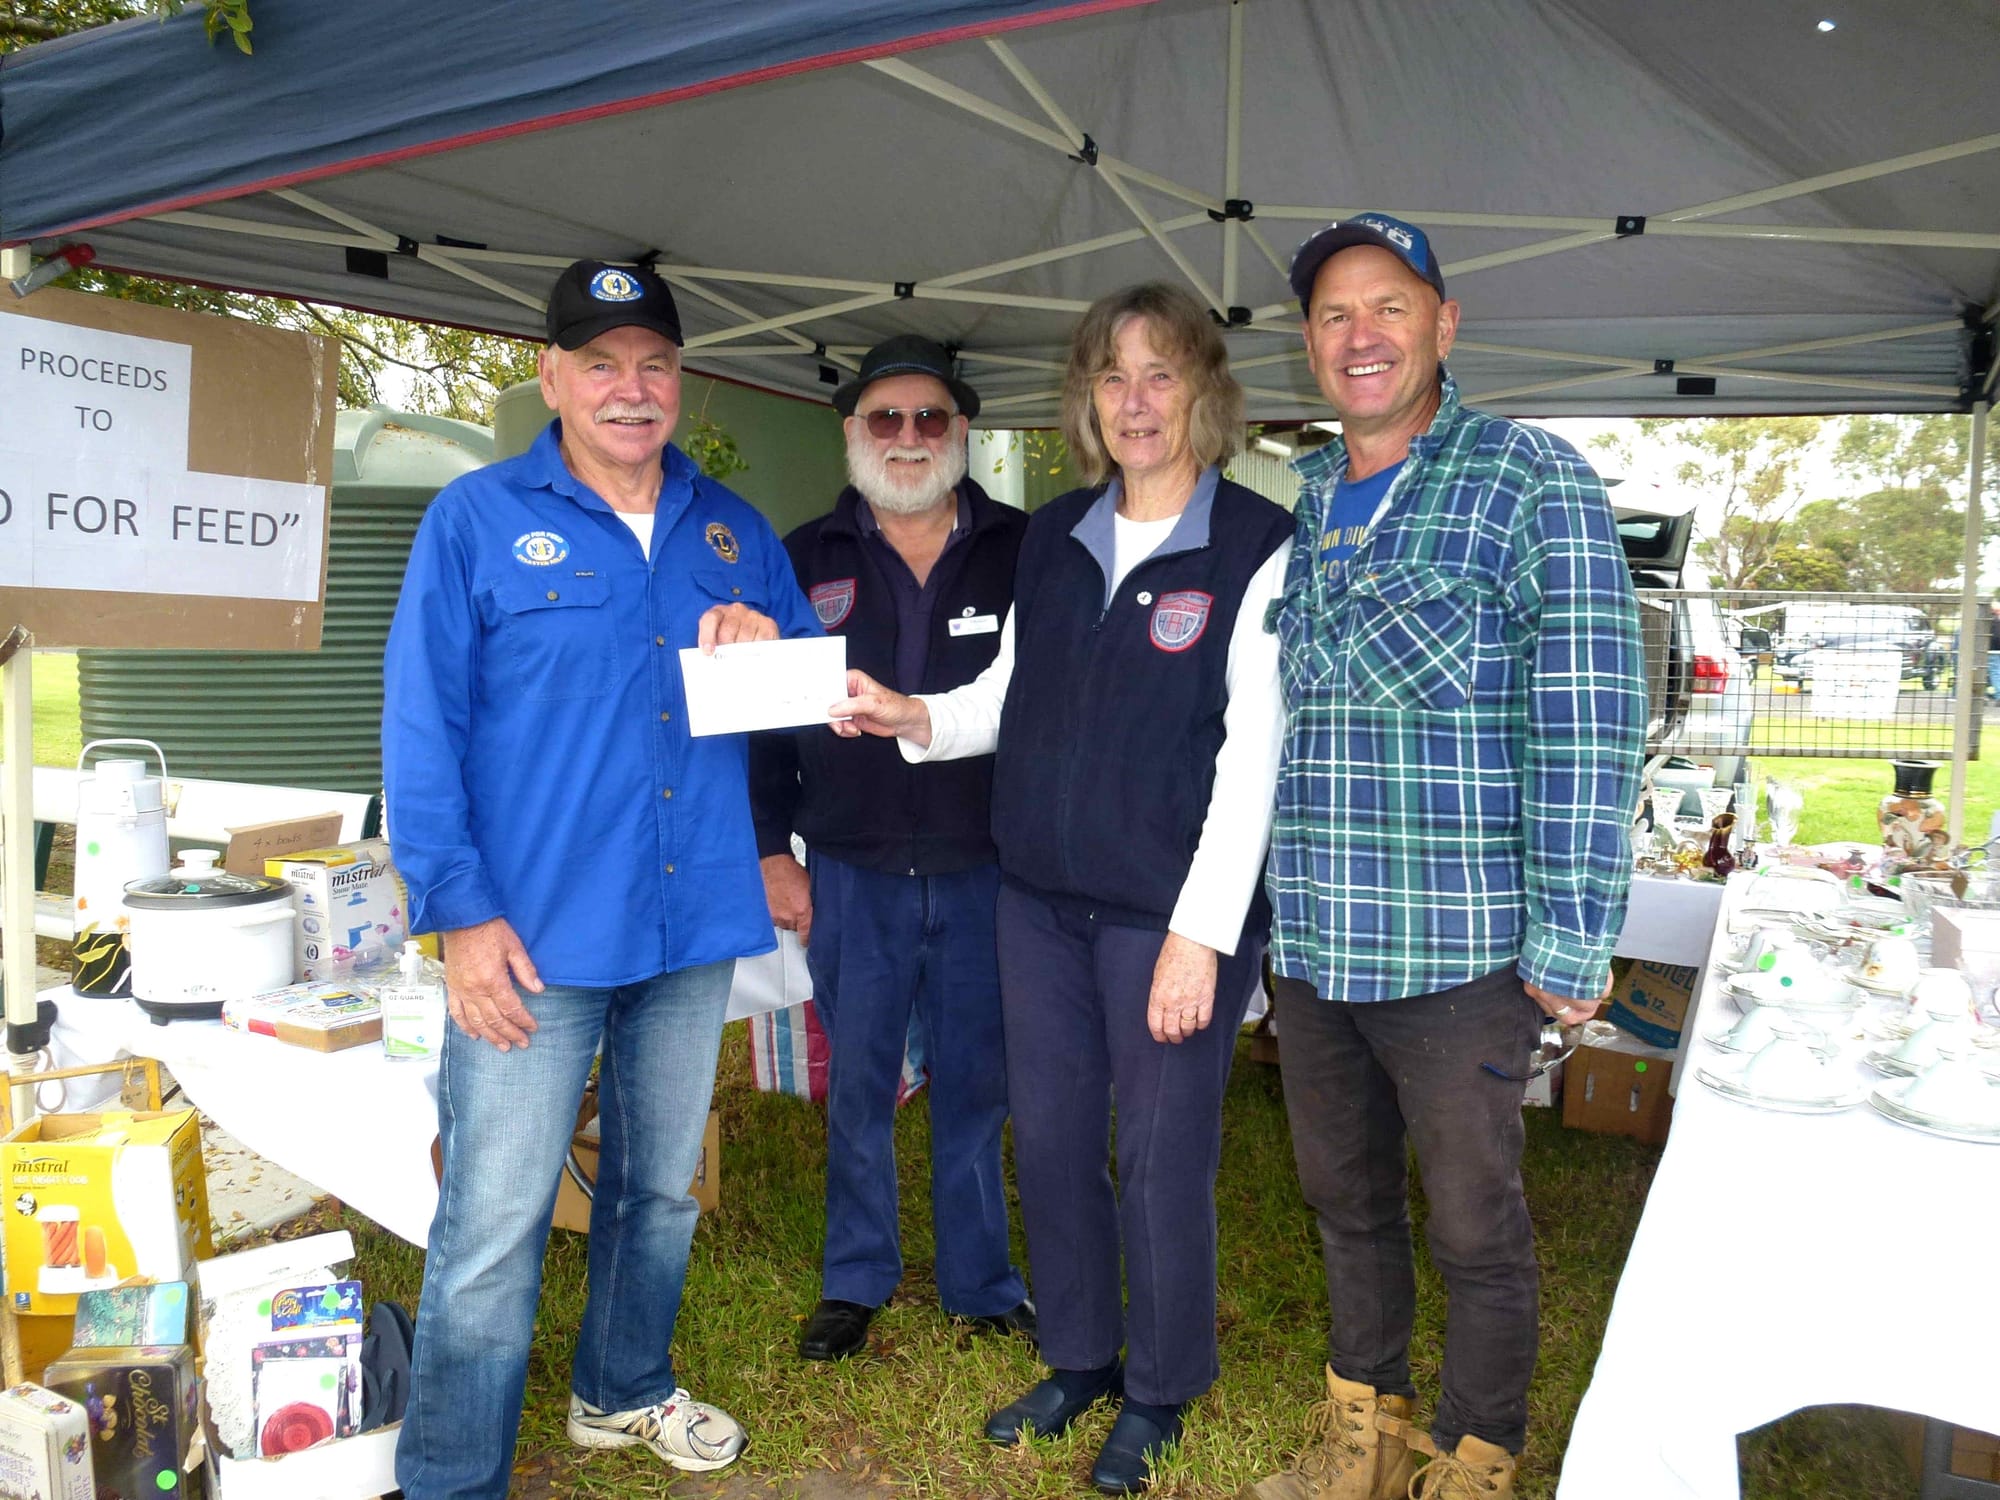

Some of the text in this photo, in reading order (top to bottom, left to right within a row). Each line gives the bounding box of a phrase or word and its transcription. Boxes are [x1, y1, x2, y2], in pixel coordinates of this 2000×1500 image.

[20, 347, 168, 392] PROCEEDS
[74, 406, 113, 432] TO
[47, 492, 139, 536] FOR
[291, 869, 316, 881] mistral
[332, 863, 388, 887] mistral
[12, 1160, 70, 1173] mistral
[148, 1399, 170, 1428] St
[627, 1415, 660, 1441] N
